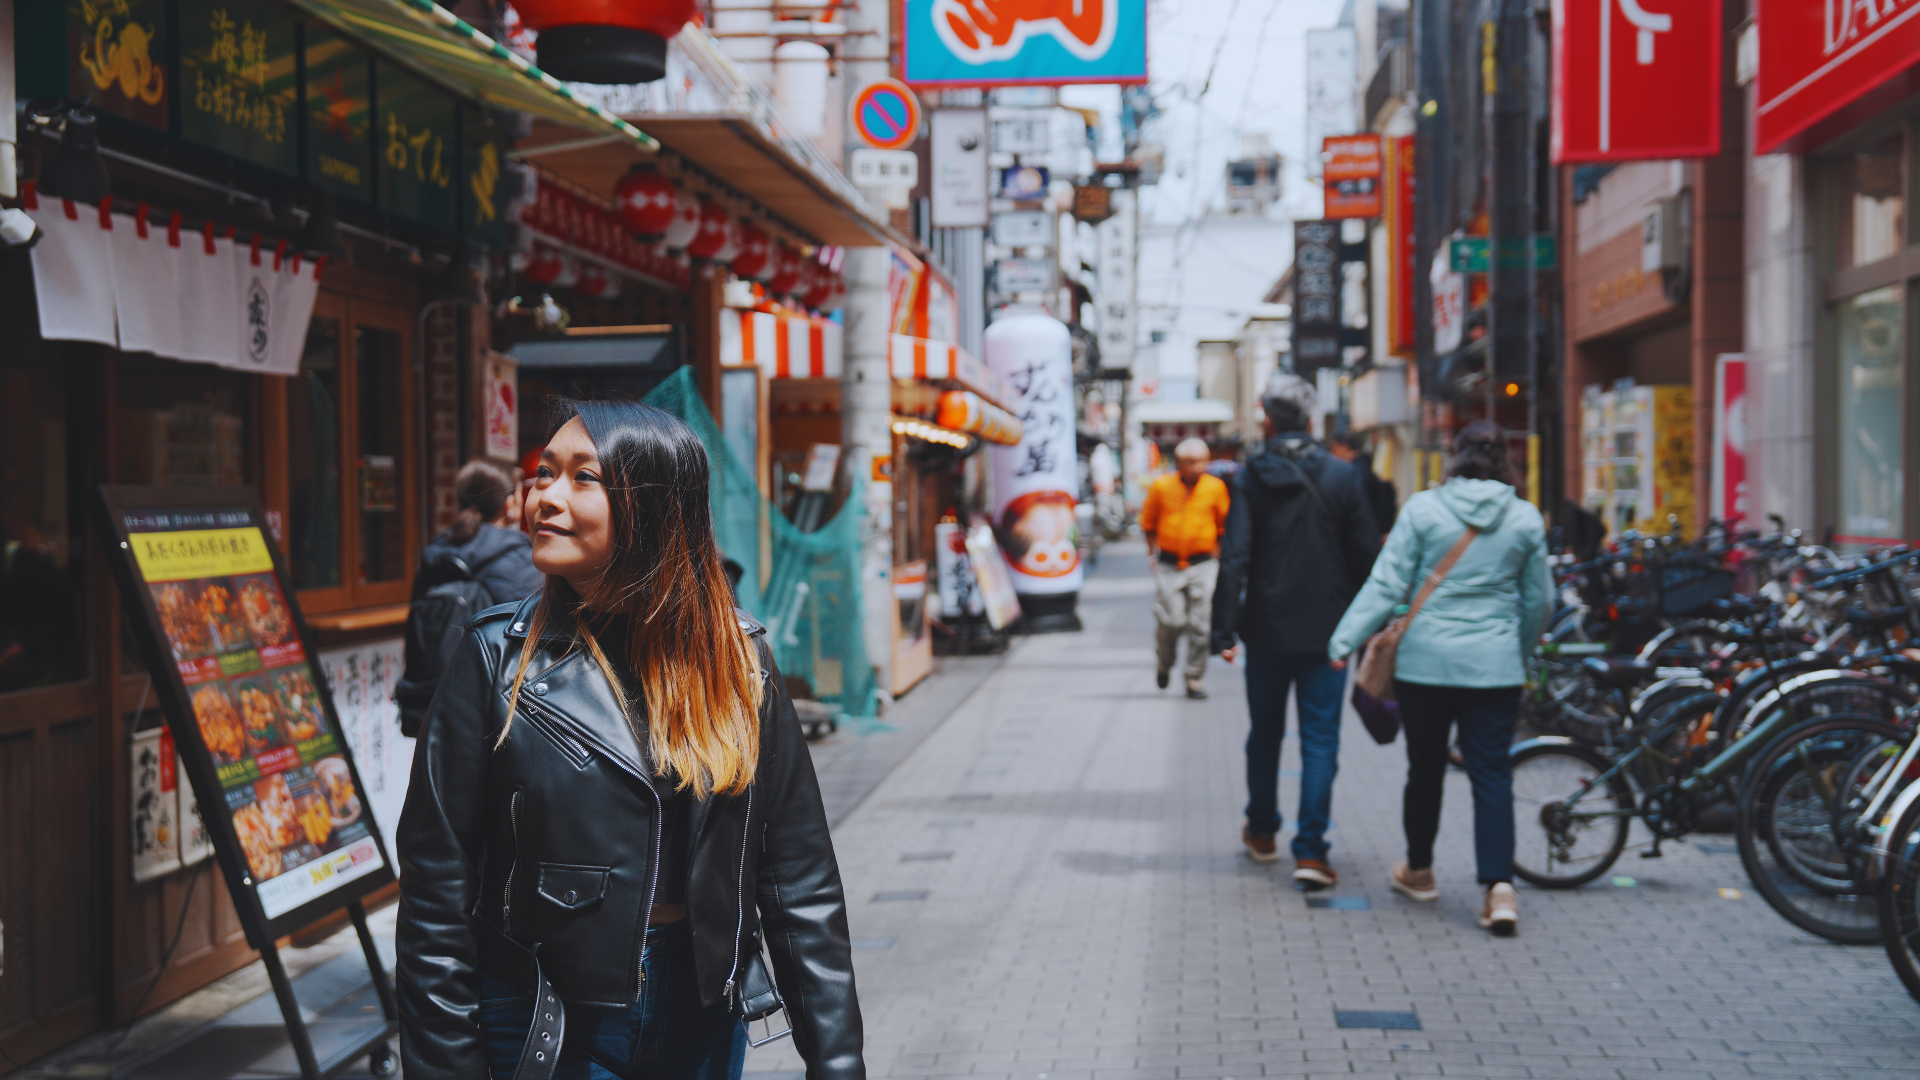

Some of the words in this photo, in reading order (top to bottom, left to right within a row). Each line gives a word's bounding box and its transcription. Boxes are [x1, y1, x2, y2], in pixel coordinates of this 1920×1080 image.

[209, 6, 272, 92] 海鮮
[196, 69, 286, 144] お好み焼き
[386, 110, 450, 189] おでん
